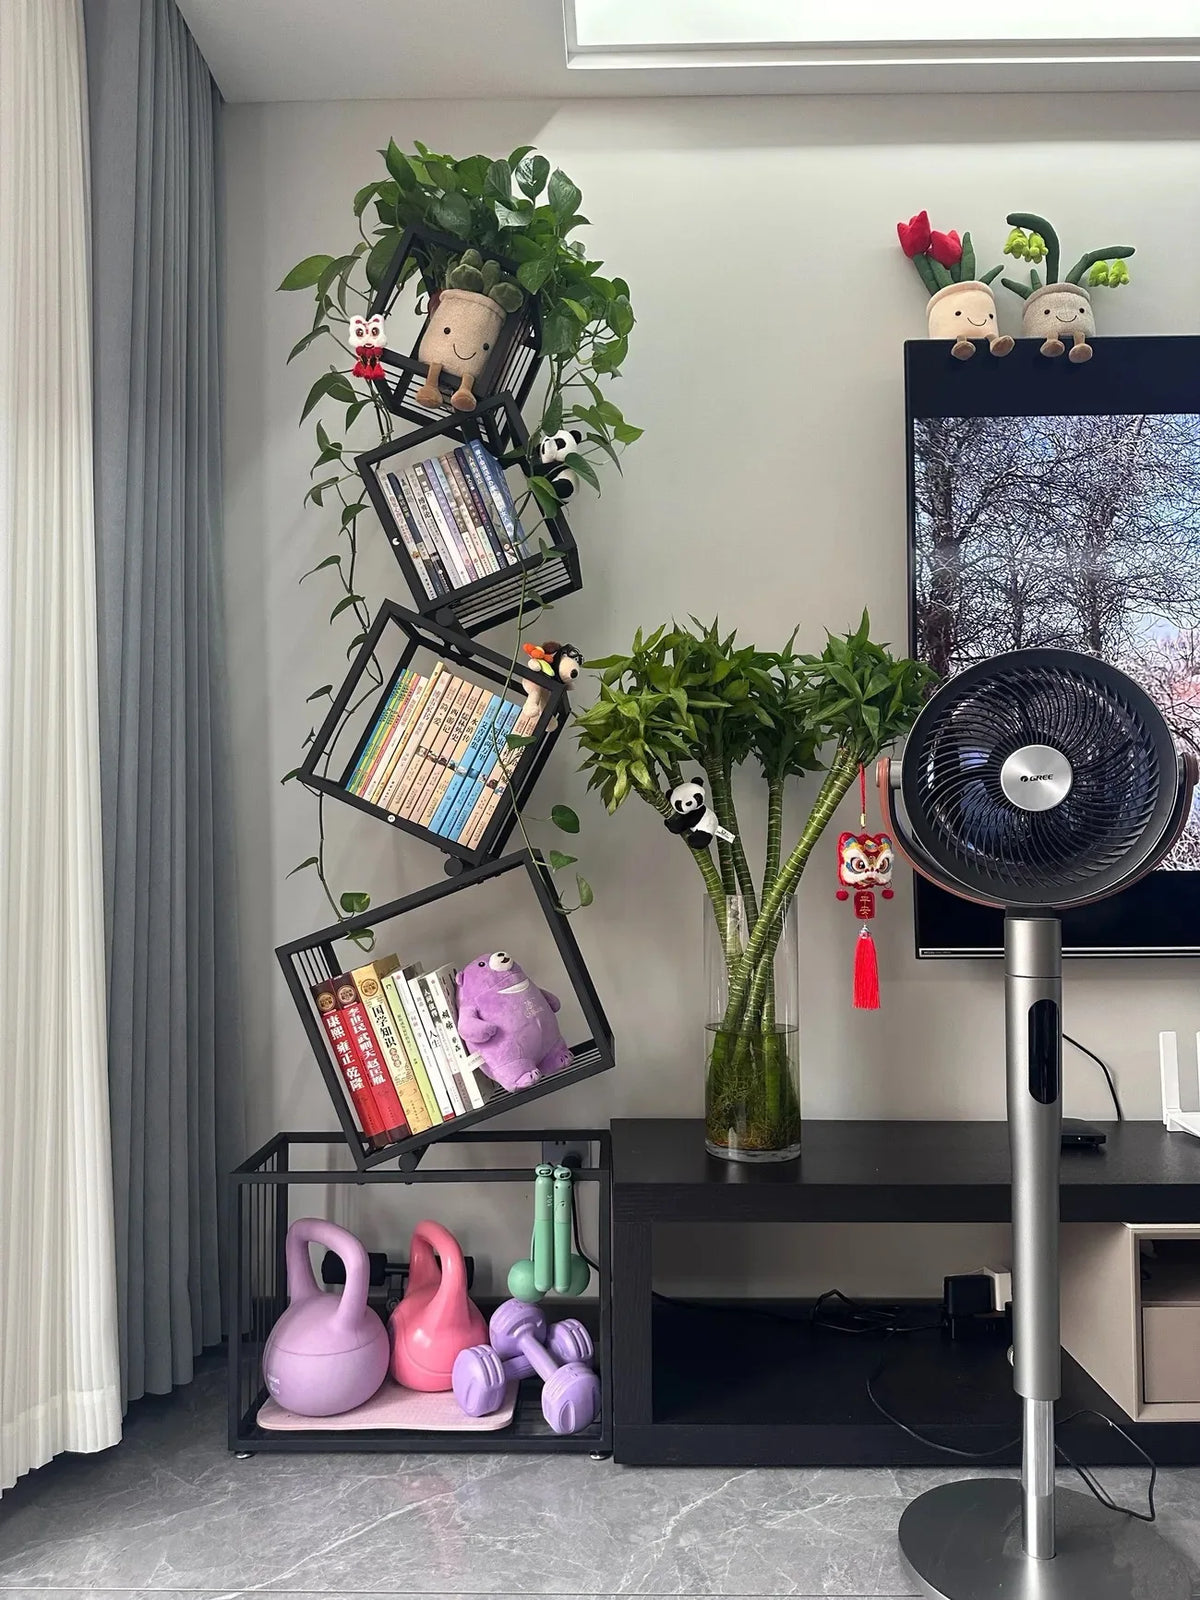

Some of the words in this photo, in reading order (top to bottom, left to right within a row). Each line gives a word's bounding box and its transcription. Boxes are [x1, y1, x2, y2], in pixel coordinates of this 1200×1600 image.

[441, 708, 459, 733] 西游记
[450, 713, 469, 741] 儒林外史
[461, 718, 478, 743] 水浒传
[470, 721, 489, 749] 艾青诗集
[1029, 774, 1054, 782] GREE
[326, 1014, 345, 1039] 康熙
[347, 1007, 365, 1032] 李世民
[335, 1040, 354, 1065] 雍正
[356, 1032, 375, 1058] 武则天
[345, 1066, 364, 1091] 乾隆
[365, 1058, 385, 1085] 赵匡胤
